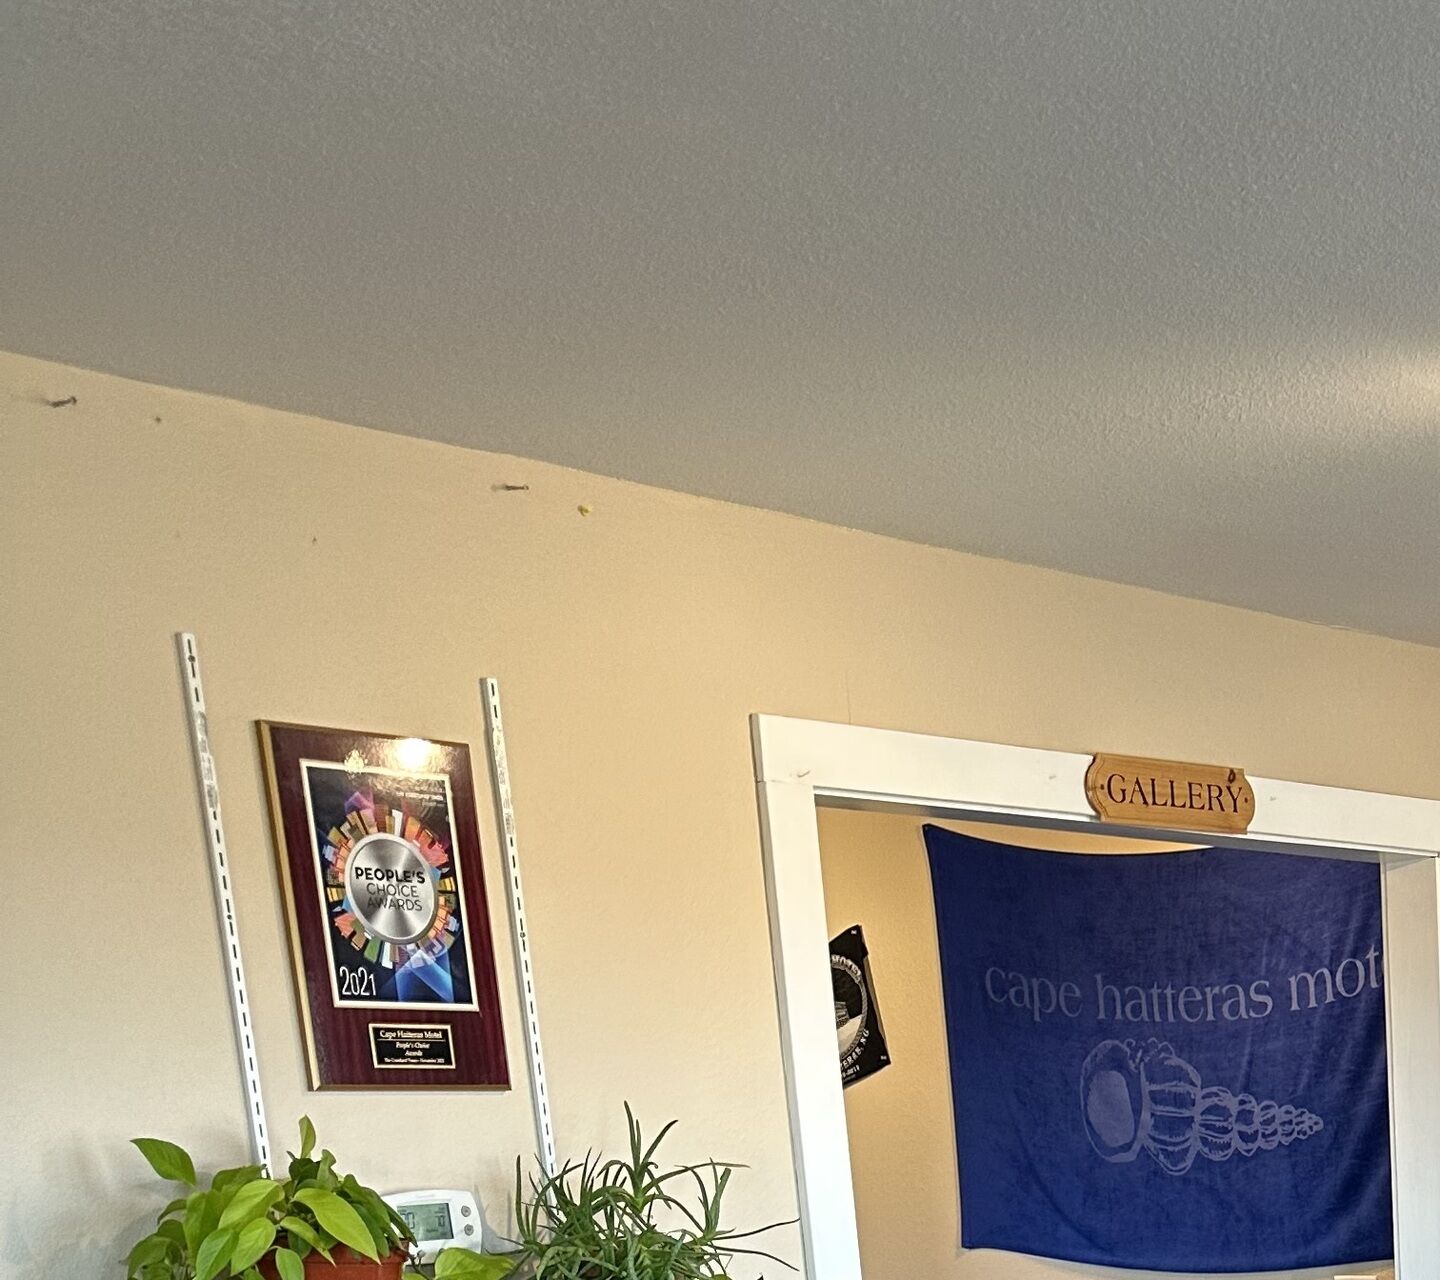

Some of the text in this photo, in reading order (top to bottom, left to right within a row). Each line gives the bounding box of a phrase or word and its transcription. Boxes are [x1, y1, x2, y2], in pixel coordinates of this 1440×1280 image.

[1107, 774, 1242, 813] GALLERY
[355, 867, 426, 884] PEOPLE'S
[366, 882, 420, 897] CHOICE
[367, 897, 423, 911] AWARDS
[339, 965, 377, 996] 2021
[985, 943, 1383, 1023] cape hatteras mot
